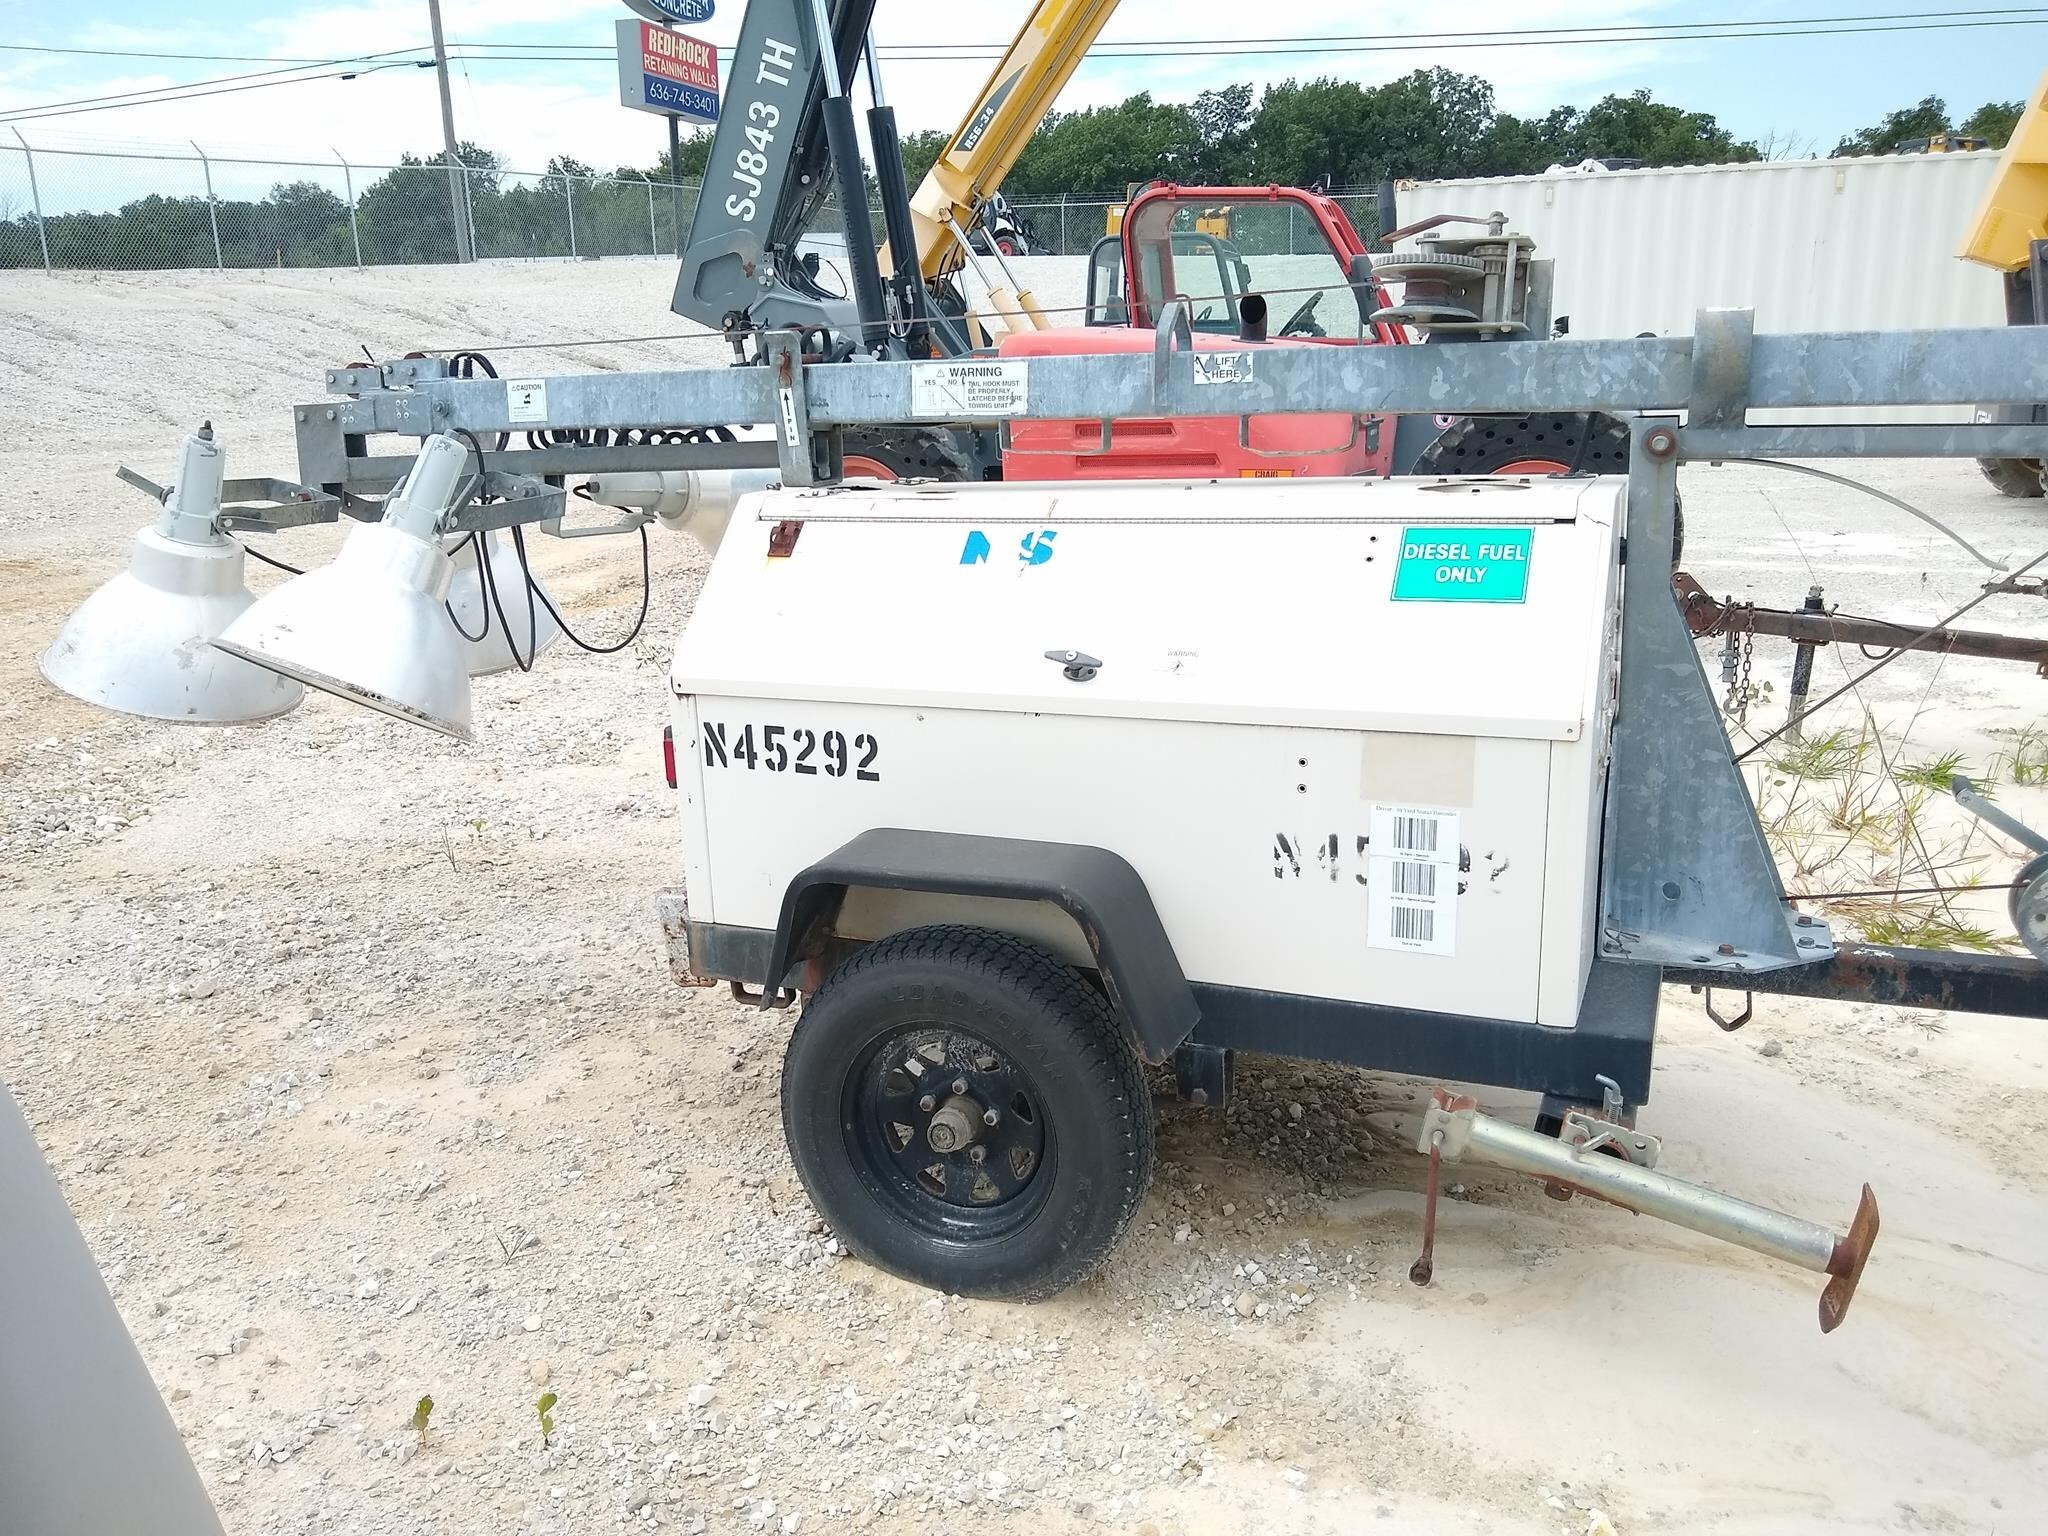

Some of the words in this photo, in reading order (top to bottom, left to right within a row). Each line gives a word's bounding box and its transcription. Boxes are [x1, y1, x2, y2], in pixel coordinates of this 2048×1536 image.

[643, 53, 689, 80] RETAINING
[689, 67, 717, 89] WALLS
[649, 82, 716, 114] 636-745-3401
[725, 101, 780, 222] SJ843
[756, 37, 797, 87] TH
[1215, 355, 1237, 366] LIFT
[949, 366, 1003, 377] WARNING
[1211, 368, 1241, 379] HERE
[515, 383, 542, 391] CAUTION
[1002, 380, 1020, 388] MUST
[1403, 543, 1471, 561] DIESEL
[1478, 543, 1527, 561] FUEL
[1435, 565, 1489, 583] ONLY
[703, 721, 881, 782] N45292
